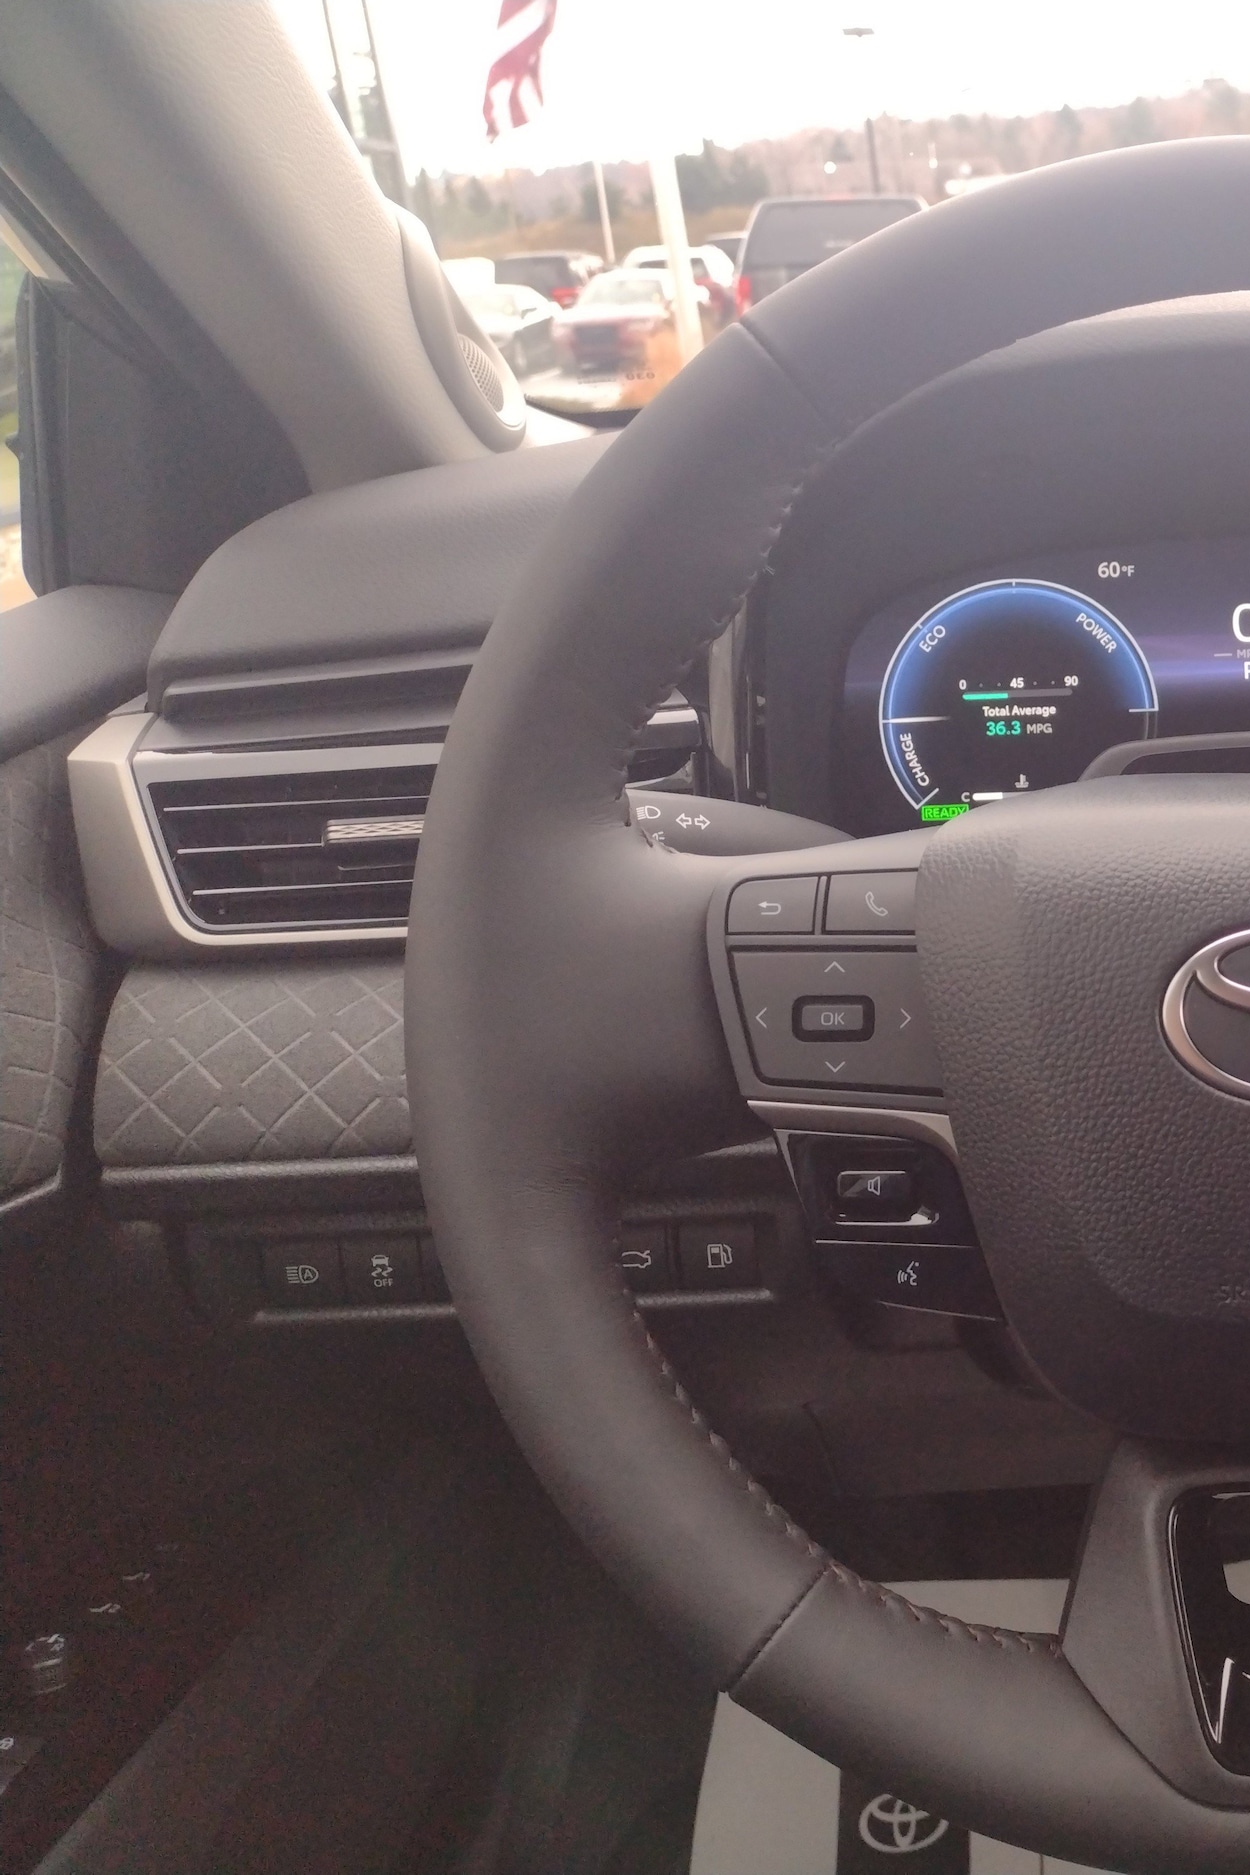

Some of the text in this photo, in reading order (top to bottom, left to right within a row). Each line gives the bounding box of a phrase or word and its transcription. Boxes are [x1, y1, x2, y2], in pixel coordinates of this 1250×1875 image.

[1097, 561, 1135, 578] 60°F
[919, 624, 947, 654] ECO
[1076, 612, 1118, 654] POWER
[958, 675, 1079, 691] 0 45 90
[982, 704, 1057, 719] Total Average
[986, 721, 1053, 737] 36.3 MPG
[900, 732, 930, 787] CHARGE
[961, 791, 970, 803] C
[924, 806, 967, 819] READY
[820, 1011, 845, 1026] OK
[374, 1278, 393, 1287] OFF
